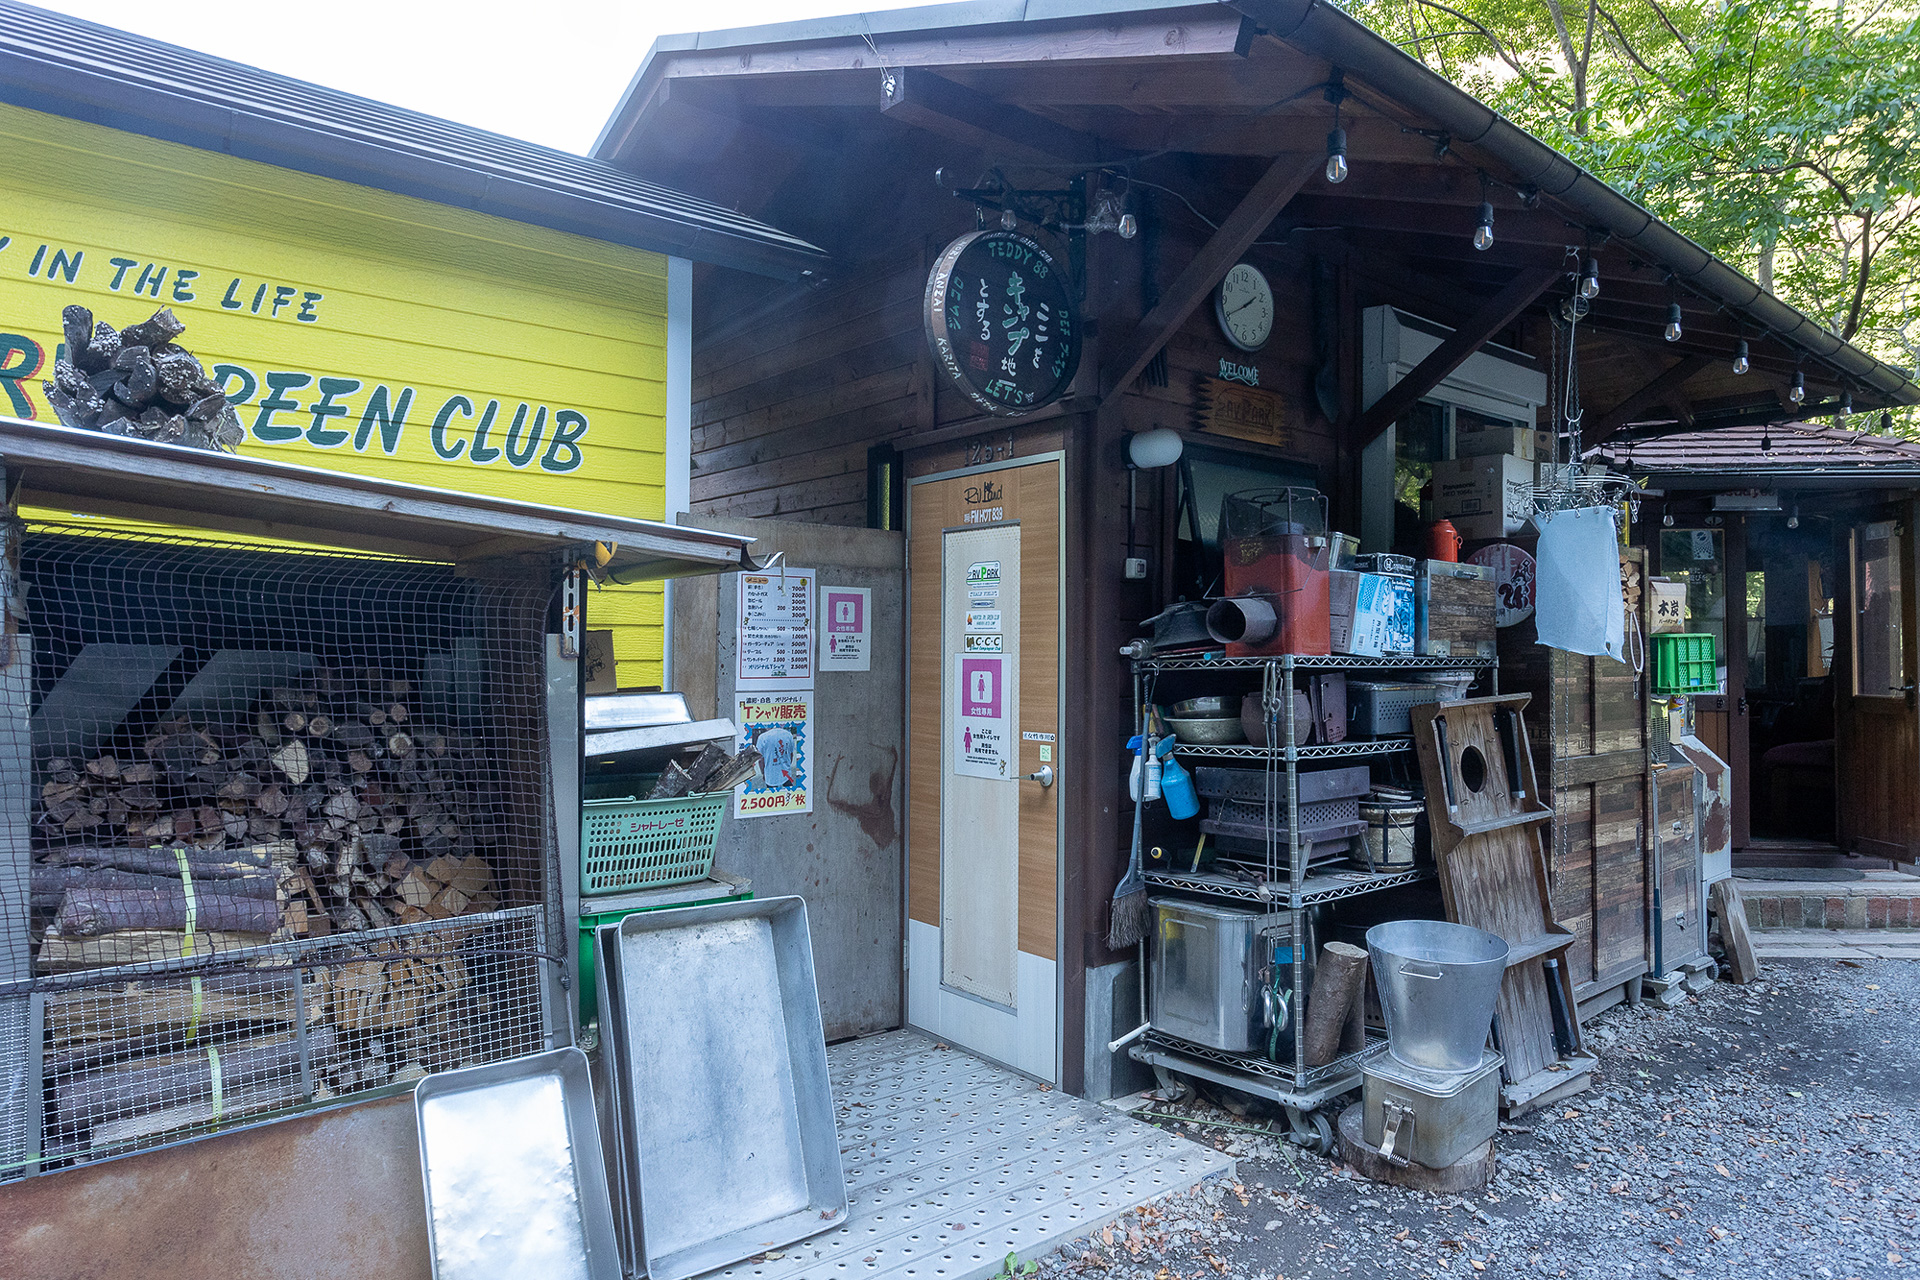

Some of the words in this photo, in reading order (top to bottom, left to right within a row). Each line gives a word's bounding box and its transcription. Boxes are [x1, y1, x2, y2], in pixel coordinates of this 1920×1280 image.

[988, 242, 1033, 264] TEDDY
[1033, 261, 1048, 279] 88
[29, 244, 84, 284] IN
[109, 256, 199, 302] THE
[220, 277, 325, 323] LIFE
[1232, 272, 1240, 285] 11
[1241, 271, 1249, 283] 12
[1225, 281, 1233, 293] 10
[1252, 279, 1257, 290] 1
[933, 272, 948, 312] ANZAI
[1259, 292, 1264, 303] 2
[1222, 294, 1228, 306] 9
[976, 278, 991, 341] とする
[1225, 310, 1231, 322] 8
[1261, 307, 1267, 318] 3
[1001, 271, 1030, 377] キャンプ地
[1233, 323, 1239, 334] 7
[1258, 321, 1263, 332] 4
[1241, 330, 1247, 341] 6
[1251, 329, 1257, 341] 5
[937, 337, 962, 379] KARITA
[1219, 358, 1259, 381] WELCOME
[985, 379, 1023, 404] LET'S
[209, 364, 417, 453] REEN
[430, 394, 590, 474] CLUB
[1442, 481, 1476, 490] Panasonic
[964, 487, 982, 505] RV
[979, 508, 992, 523] HOT
[1657, 599, 1679, 617] 木炭
[743, 704, 806, 719] Tシャツ販売
[970, 707, 992, 716] 女性専用
[973, 733, 1000, 741] 女性用トイレです
[630, 817, 685, 833] シャトレーゼ
